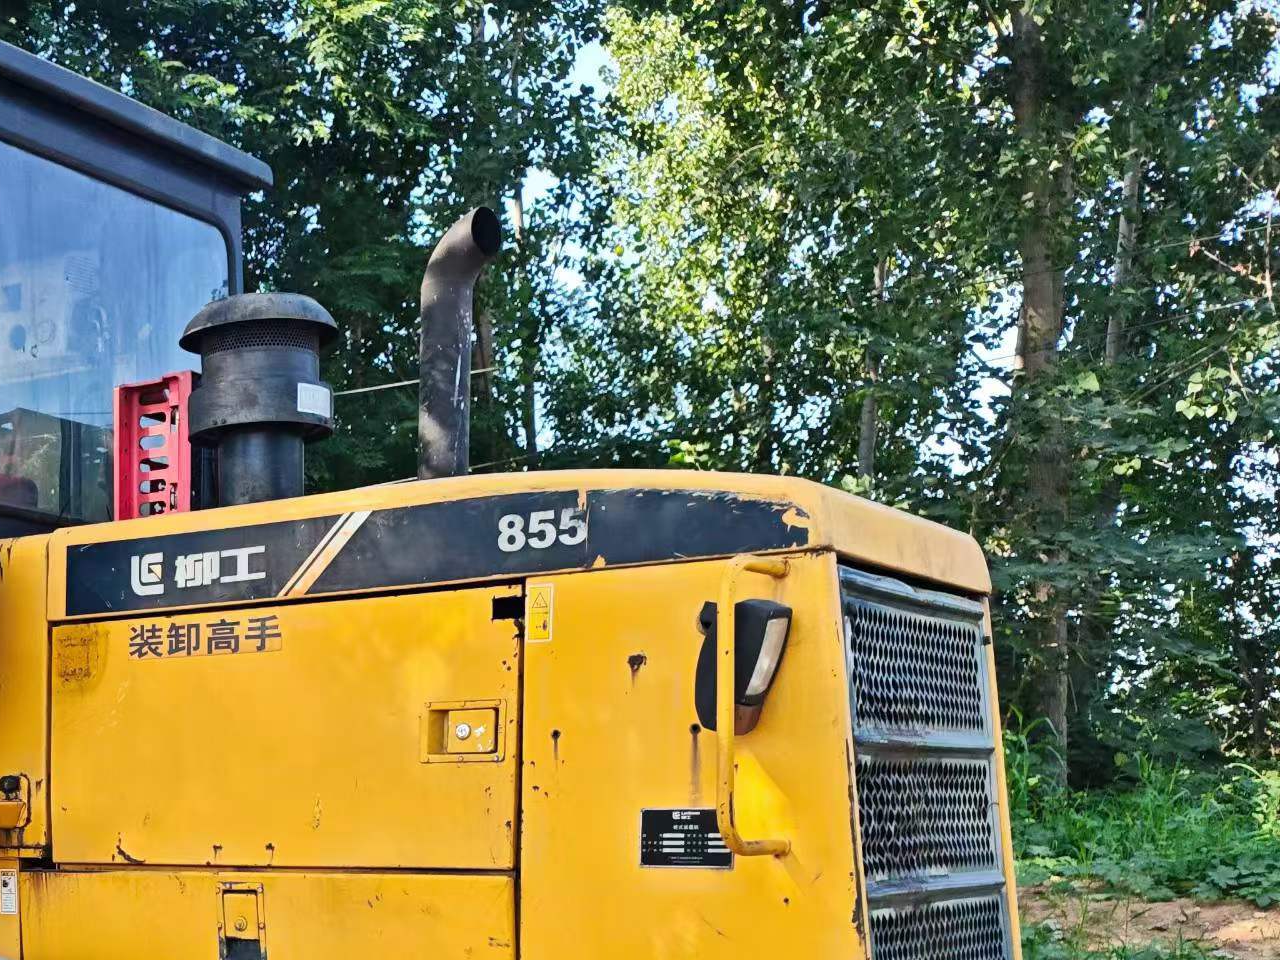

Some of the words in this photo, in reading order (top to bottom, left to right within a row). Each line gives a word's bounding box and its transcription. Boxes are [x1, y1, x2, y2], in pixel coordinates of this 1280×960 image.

[497, 507, 588, 552] 855
[174, 545, 267, 589] 柳工
[129, 614, 282, 660] 装卸高手
